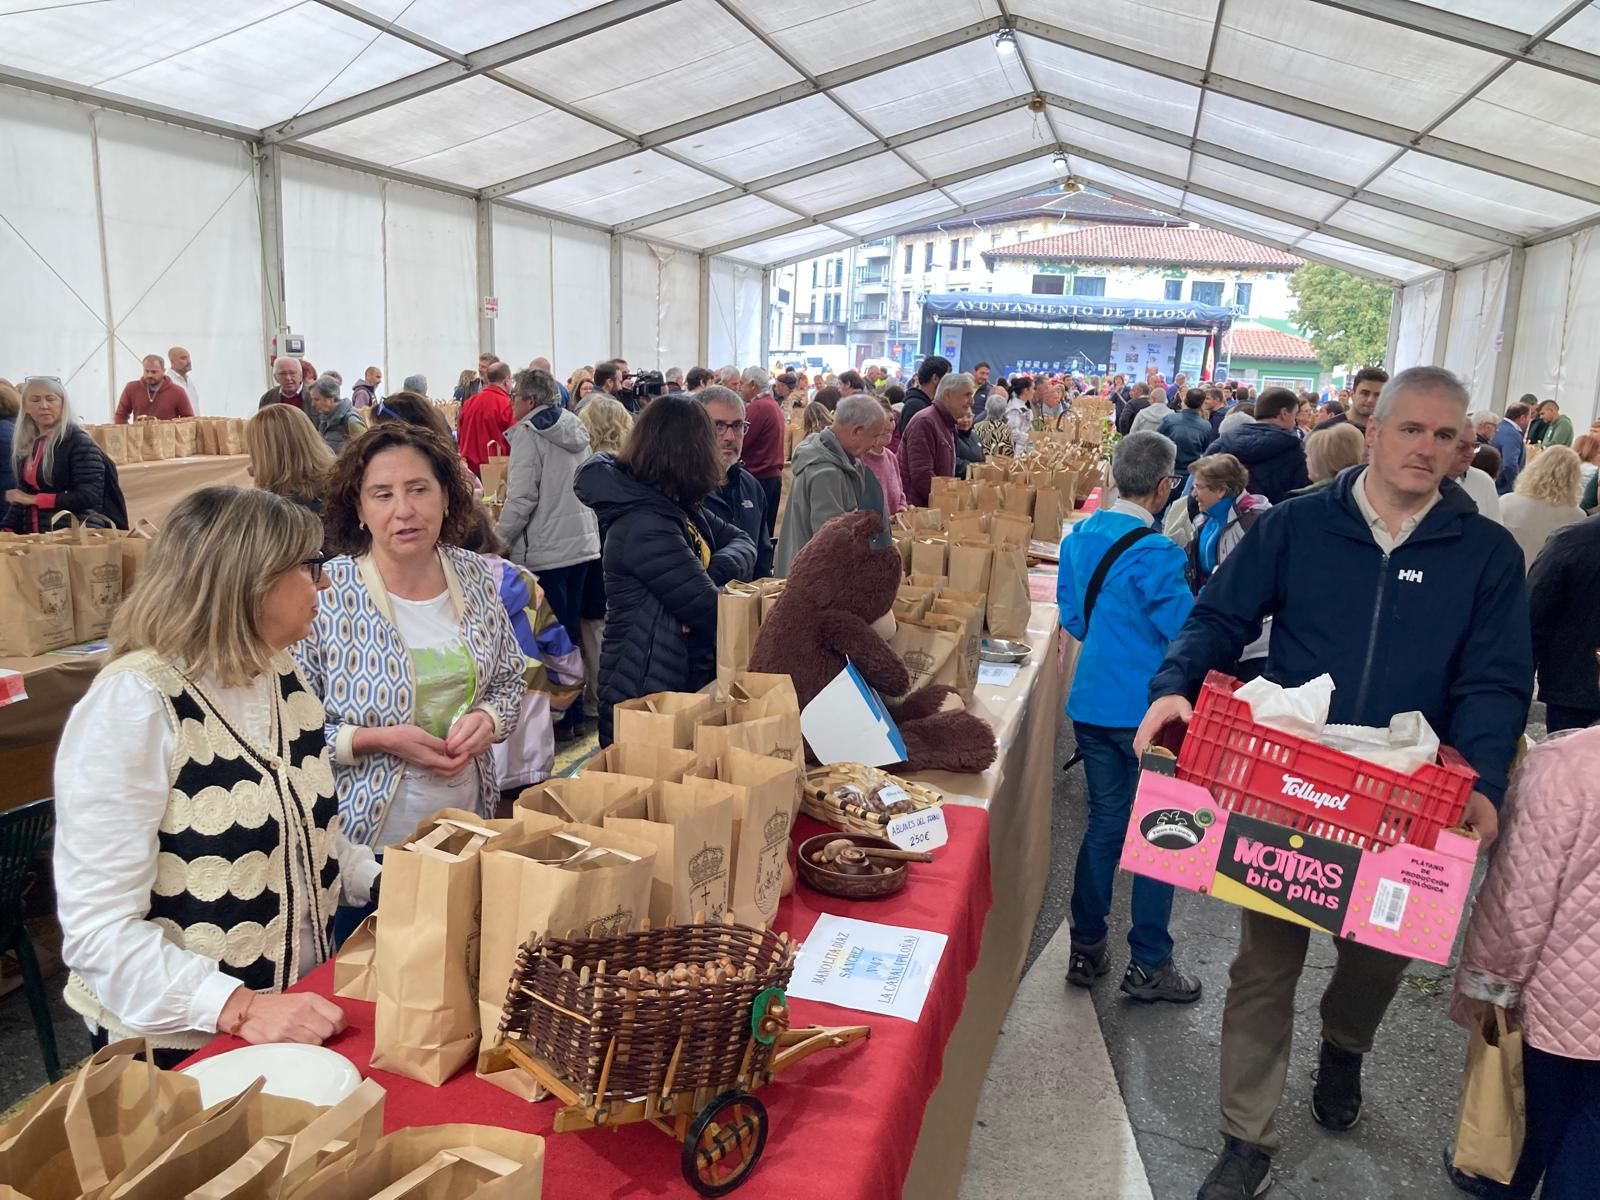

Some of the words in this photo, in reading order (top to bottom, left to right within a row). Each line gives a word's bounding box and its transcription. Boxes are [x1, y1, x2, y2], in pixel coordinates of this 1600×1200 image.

[956, 300, 1094, 316] AYUNTAMIENTO
[1103, 307, 1125, 317] DE
[1398, 569, 1423, 583] HH
[1411, 858, 1444, 872] PLÁTANO
[1246, 868, 1283, 892] bio
[1287, 883, 1340, 909] plus
